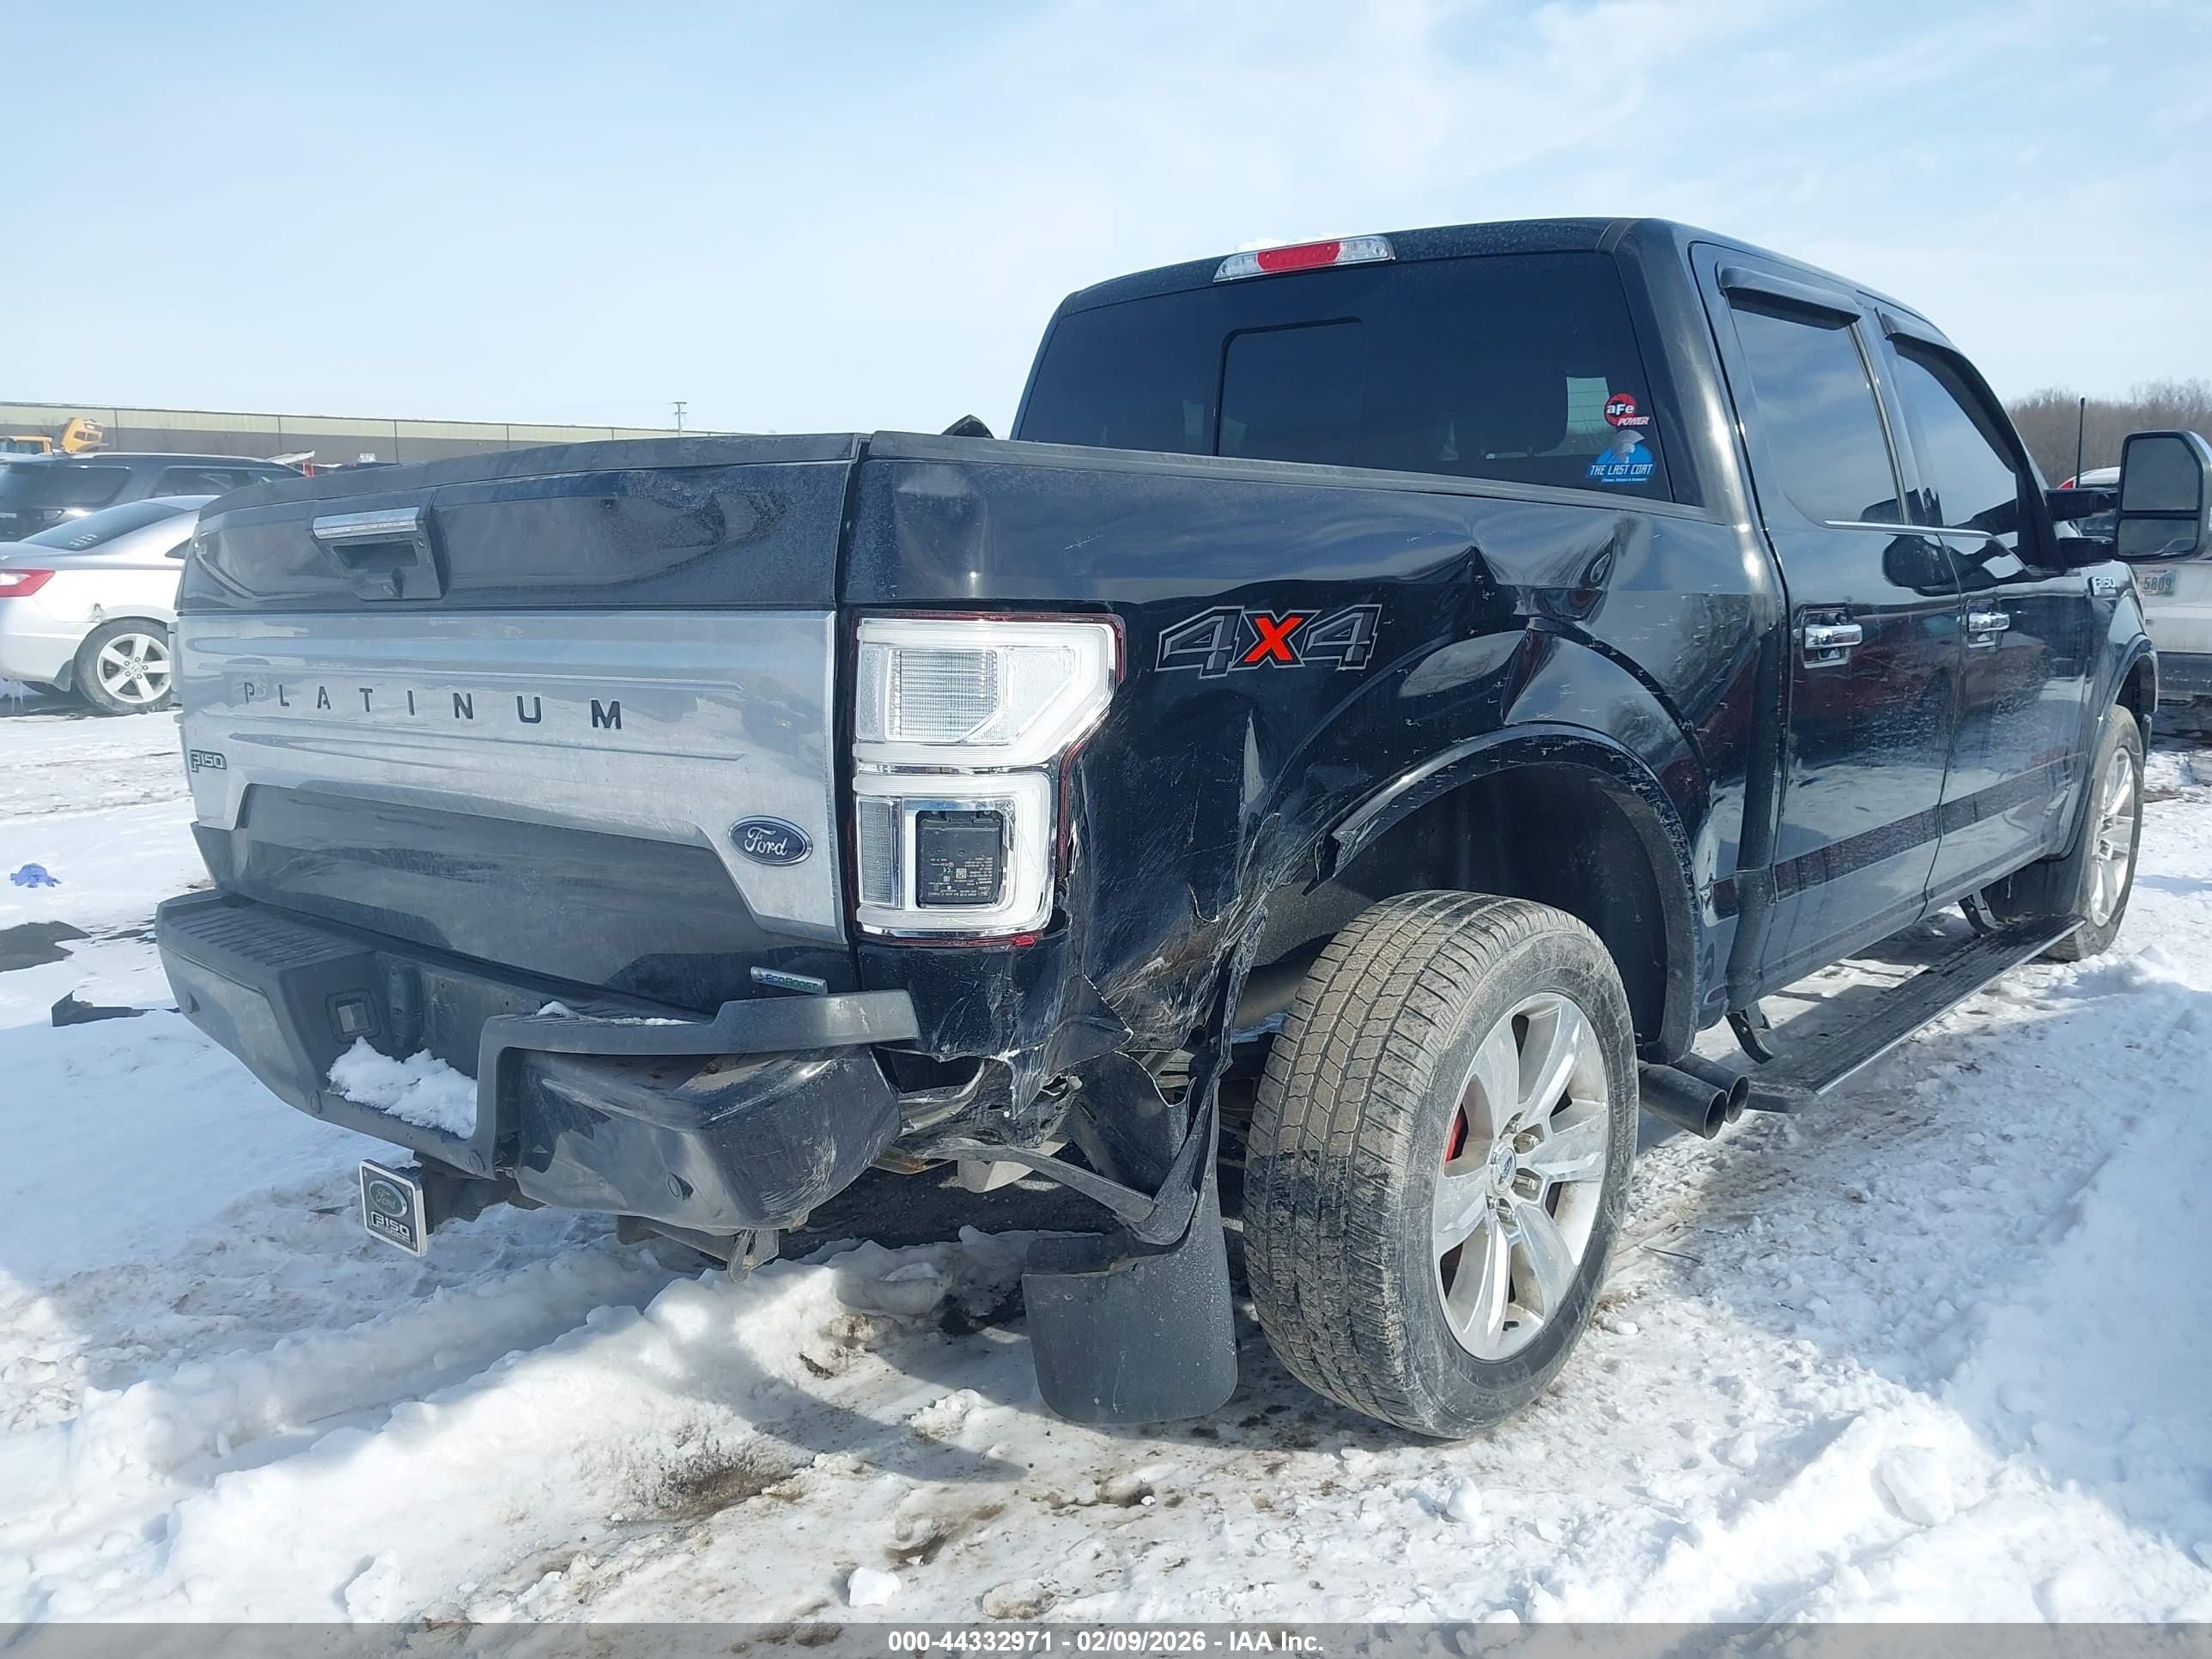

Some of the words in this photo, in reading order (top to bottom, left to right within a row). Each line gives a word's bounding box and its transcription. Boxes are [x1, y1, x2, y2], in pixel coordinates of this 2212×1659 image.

[1607, 404, 1635, 415] aFe
[1617, 416, 1650, 426] POWER
[1589, 465, 1607, 476] THE
[1607, 465, 1631, 476] LAST
[1630, 464, 1654, 475] COAT
[2142, 576, 2172, 591] 5809
[244, 681, 623, 730] PLATINUM
[744, 826, 788, 856] Ford
[375, 1188, 396, 1210] Ford
